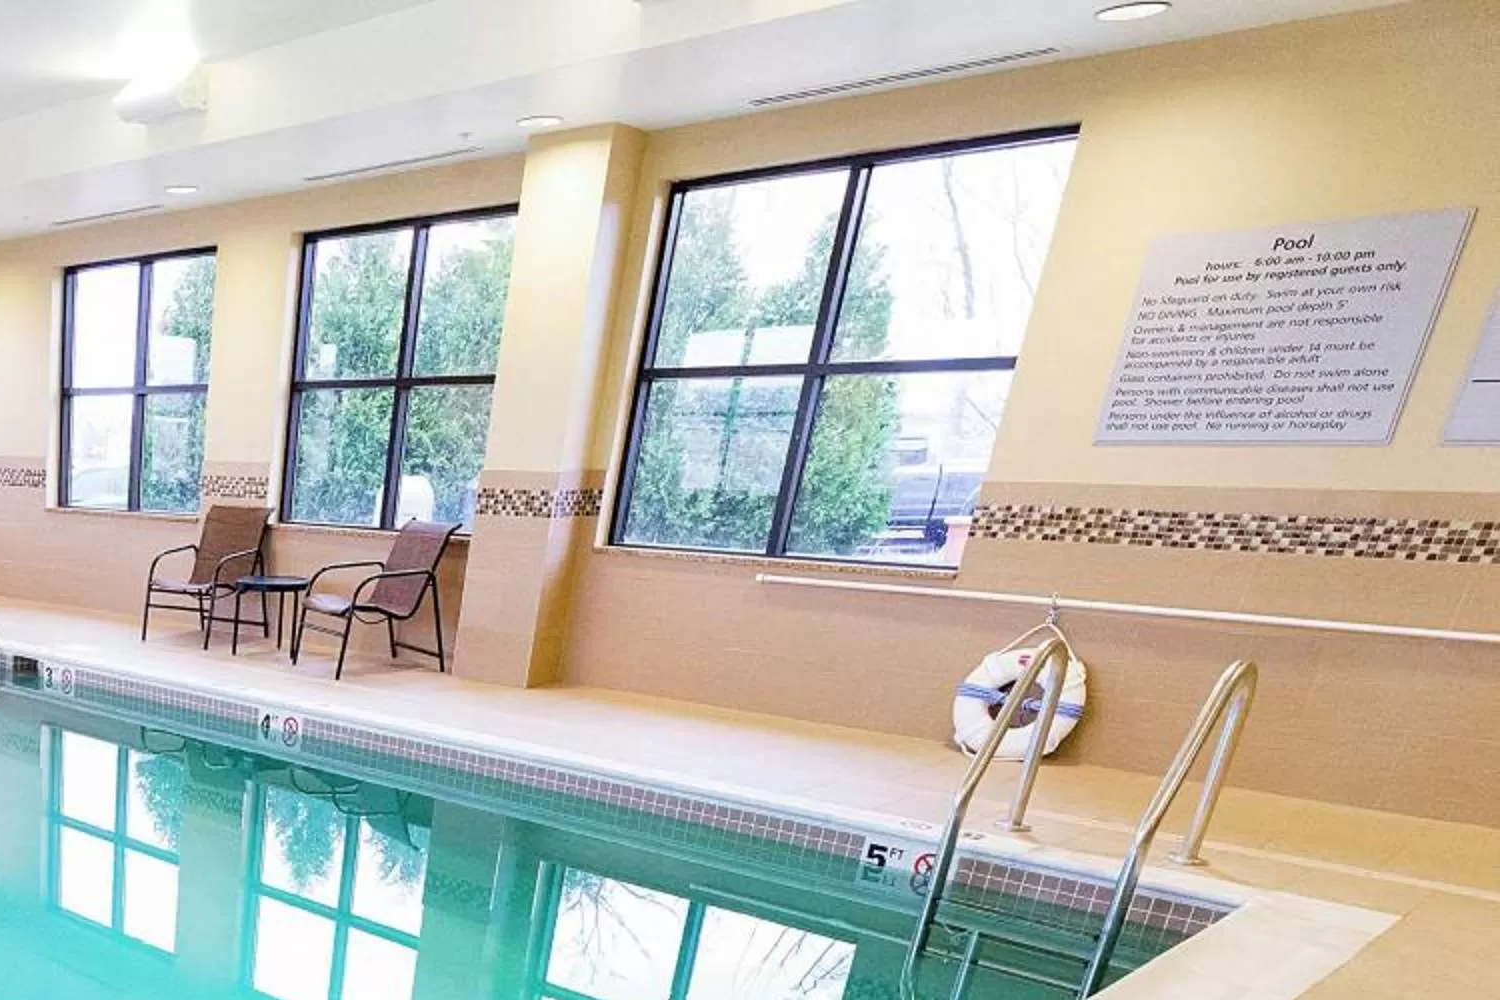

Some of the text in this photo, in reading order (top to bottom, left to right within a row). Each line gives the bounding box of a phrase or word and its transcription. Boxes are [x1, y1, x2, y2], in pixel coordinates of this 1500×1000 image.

[1273, 234, 1315, 251] Pool
[1254, 255, 1281, 266] 6:00
[1284, 256, 1305, 265] am
[1316, 252, 1350, 262] 10:00
[1353, 250, 1375, 261] pm
[1174, 275, 1199, 286] Pool
[1203, 274, 1219, 284] for
[1223, 274, 1242, 282] use
[1245, 271, 1260, 282] by
[1264, 266, 1327, 280] registered
[1330, 264, 1372, 277] guests
[1142, 296, 1156, 306] No
[1212, 294, 1227, 302] on
[1267, 289, 1298, 298] Swim
[1301, 287, 1315, 297] at
[1316, 286, 1345, 298] your
[1348, 284, 1377, 294] own
[1138, 311, 1156, 320] NO
[1208, 306, 1263, 316] Maximum
[1266, 303, 1294, 314] pool
[1297, 301, 1333, 312] depth
[1134, 325, 1173, 335] Owners
[1190, 321, 1263, 332] management
[1266, 320, 1285, 328] are
[1289, 318, 1309, 327] not
[1314, 313, 1383, 327] responsible
[1131, 336, 1145, 345] for
[1147, 334, 1197, 345] accidents
[1220, 345, 1265, 356] children
[1269, 343, 1304, 353] under
[1324, 341, 1355, 352] must
[1359, 340, 1376, 350] be
[1195, 358, 1207, 369] by
[1222, 355, 1286, 367] responsible
[1288, 353, 1321, 364] adult
[1148, 373, 1202, 382] containers
[1274, 369, 1291, 379] Do
[1294, 369, 1315, 378] not
[1318, 368, 1351, 378] swim
[1354, 367, 1389, 377] alone
[1116, 382, 1395, 397] Persons with communicable diseases shall not use
[1144, 397, 1184, 407] Shower
[1186, 396, 1223, 406] before
[1225, 395, 1275, 406] entering
[1277, 393, 1305, 406] pool
[1109, 407, 1372, 421] Persons under the influence of alcohol or drugs
[1131, 422, 1148, 430] not
[1206, 421, 1221, 430] No
[1224, 421, 1268, 432] running
[1272, 421, 1285, 429] or
[1287, 419, 1347, 431] horseplay
[867, 844, 904, 867] 5 FT
